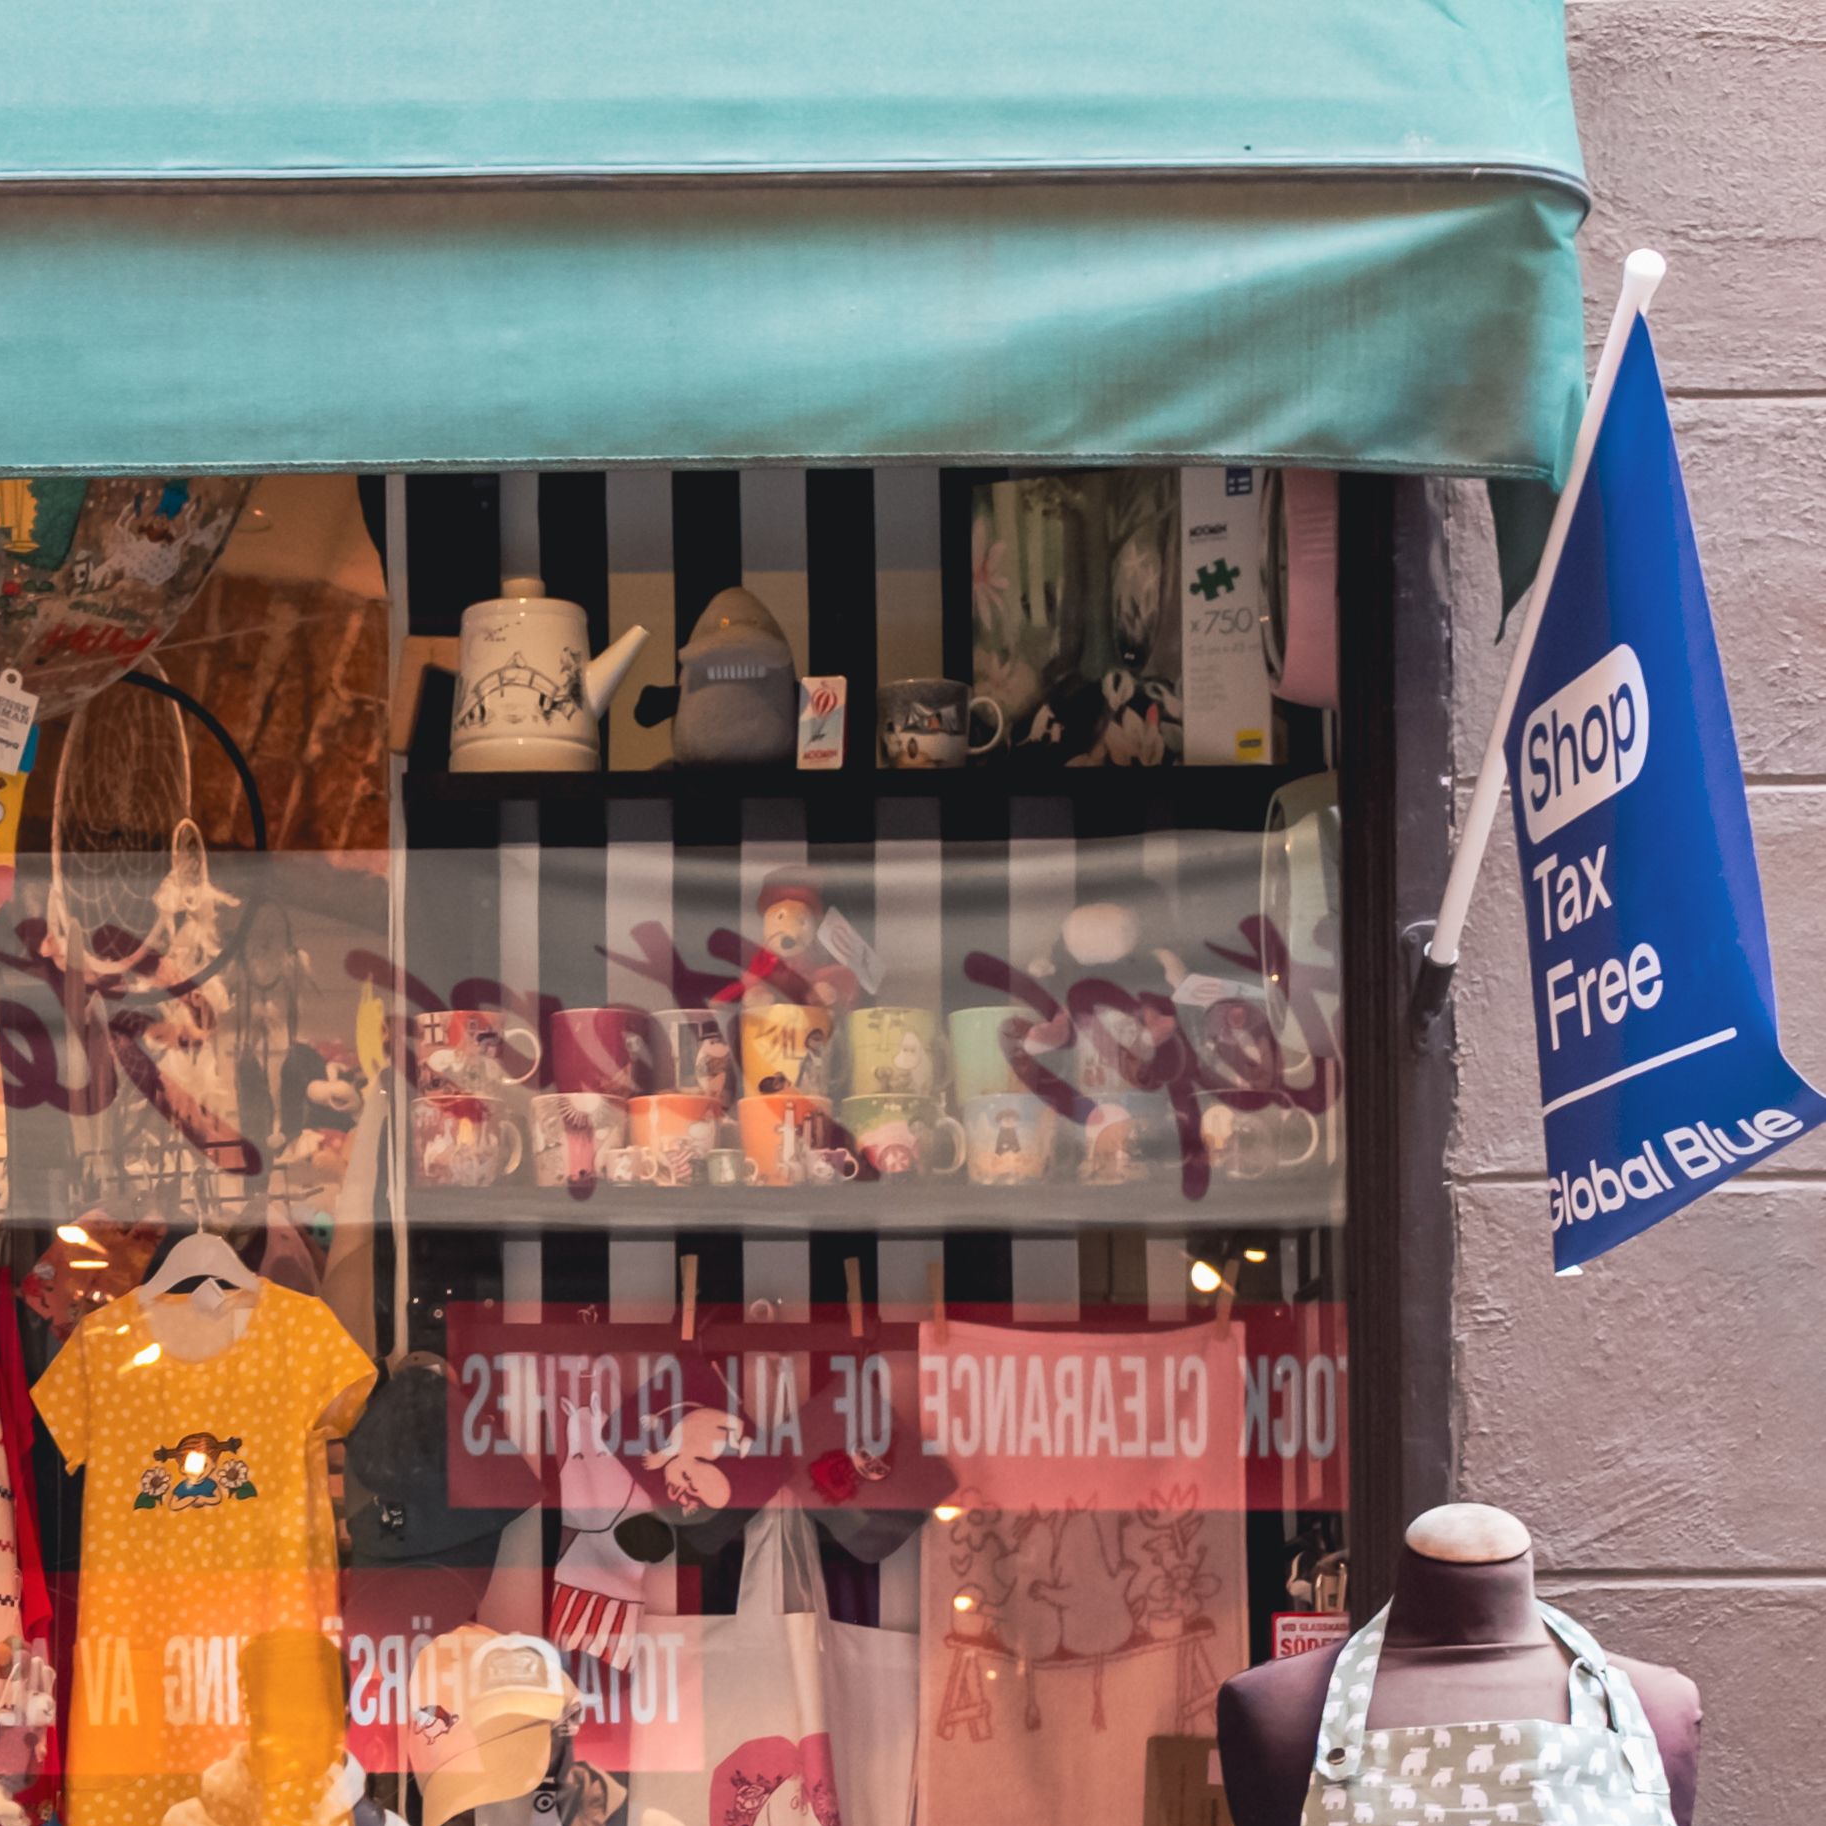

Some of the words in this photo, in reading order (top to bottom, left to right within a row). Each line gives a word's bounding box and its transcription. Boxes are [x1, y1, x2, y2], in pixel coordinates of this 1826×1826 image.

[1526, 676, 1637, 808] Shop
[1532, 843, 1612, 942] Tax
[1544, 941, 1664, 1052] Free
[1547, 1136, 1673, 1232] Global
[1677, 1105, 1803, 1183] Blue
